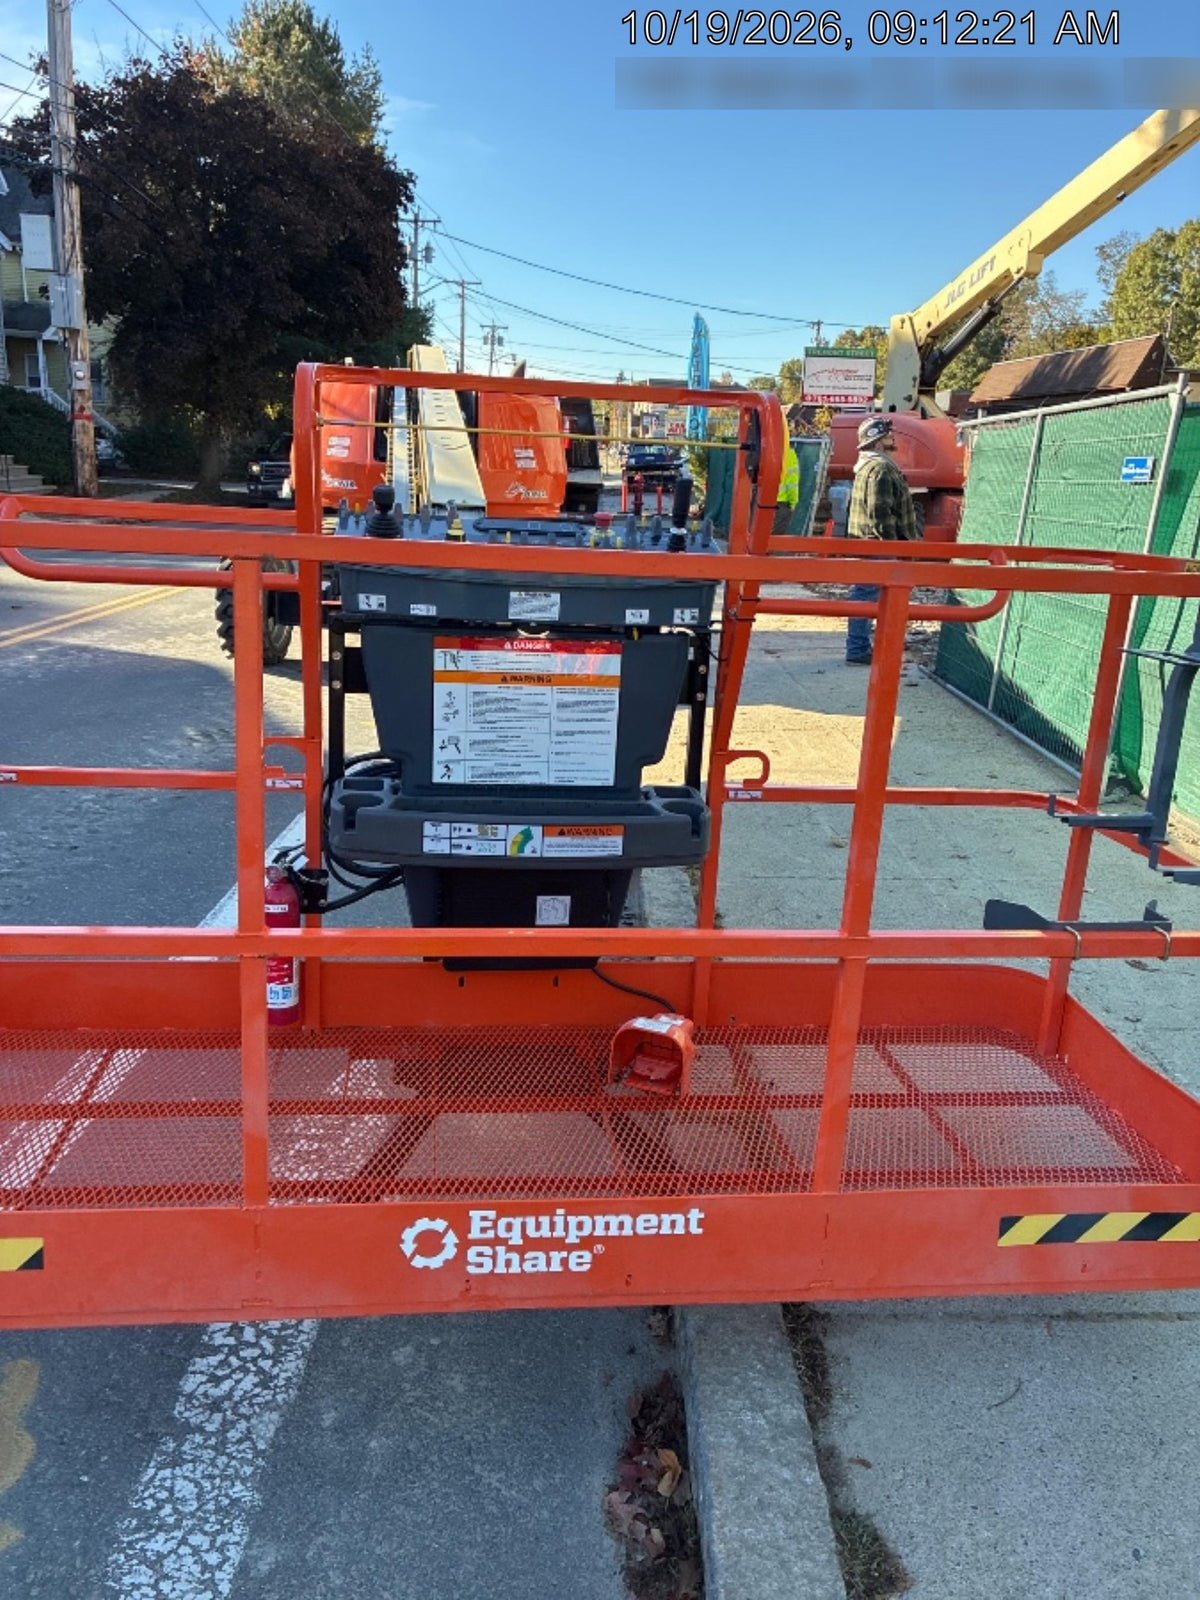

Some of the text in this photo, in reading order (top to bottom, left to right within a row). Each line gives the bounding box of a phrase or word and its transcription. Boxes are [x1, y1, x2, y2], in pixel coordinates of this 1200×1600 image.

[969, 255, 996, 288] LIFT
[513, 640, 552, 650] DANGER
[510, 675, 552, 684] WARNING
[467, 1208, 704, 1245] Equipment
